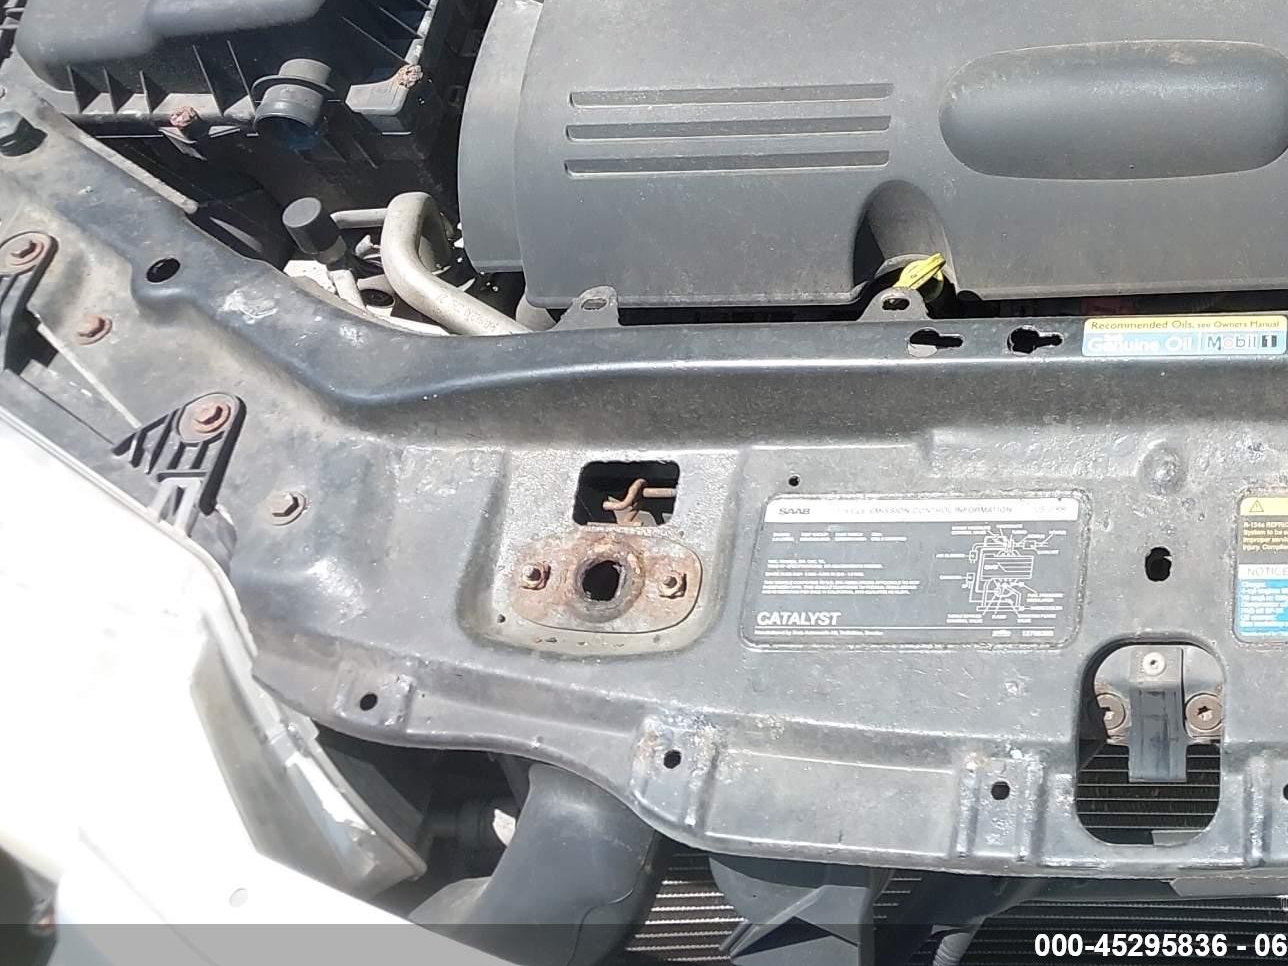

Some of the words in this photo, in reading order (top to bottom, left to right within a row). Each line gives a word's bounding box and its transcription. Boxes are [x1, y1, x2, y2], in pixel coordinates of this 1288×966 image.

[1091, 320, 1168, 330] Recommended
[1250, 320, 1280, 328] Manual
[1207, 335, 1256, 351] Mobil
[778, 507, 811, 515] SAAB
[954, 505, 1013, 514] INFORMATION
[1247, 567, 1288, 577] NOTICE
[756, 611, 842, 626] CATALYST
